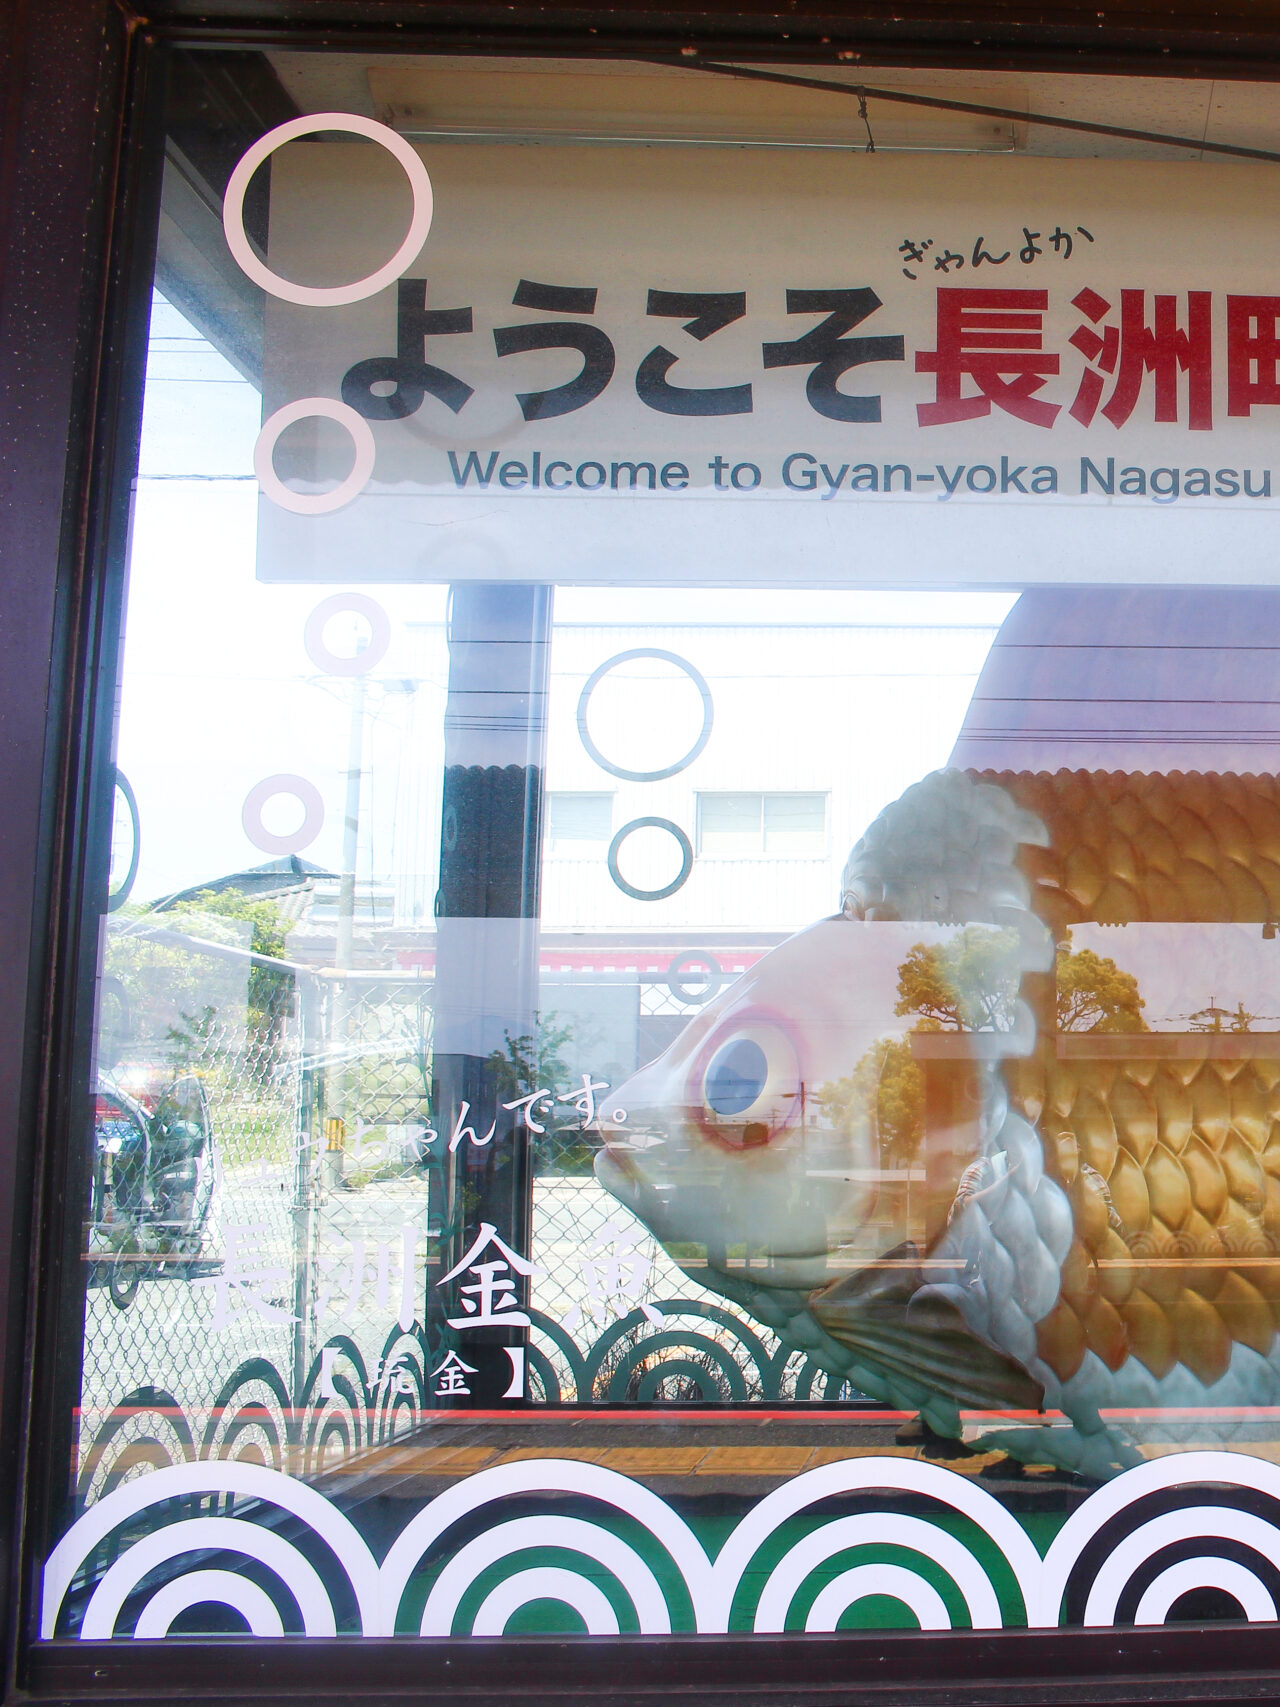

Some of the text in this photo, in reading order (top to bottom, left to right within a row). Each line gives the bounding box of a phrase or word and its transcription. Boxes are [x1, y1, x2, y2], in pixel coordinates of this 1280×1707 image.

[898, 227, 1094, 280] ぎゃんよか
[447, 451, 690, 492] Welcome
[708, 455, 762, 492] to
[781, 453, 1058, 501] Gyan-yoka
[1079, 456, 1272, 504] Nagasu
[190, 1222, 665, 1333] 長洲金魚
